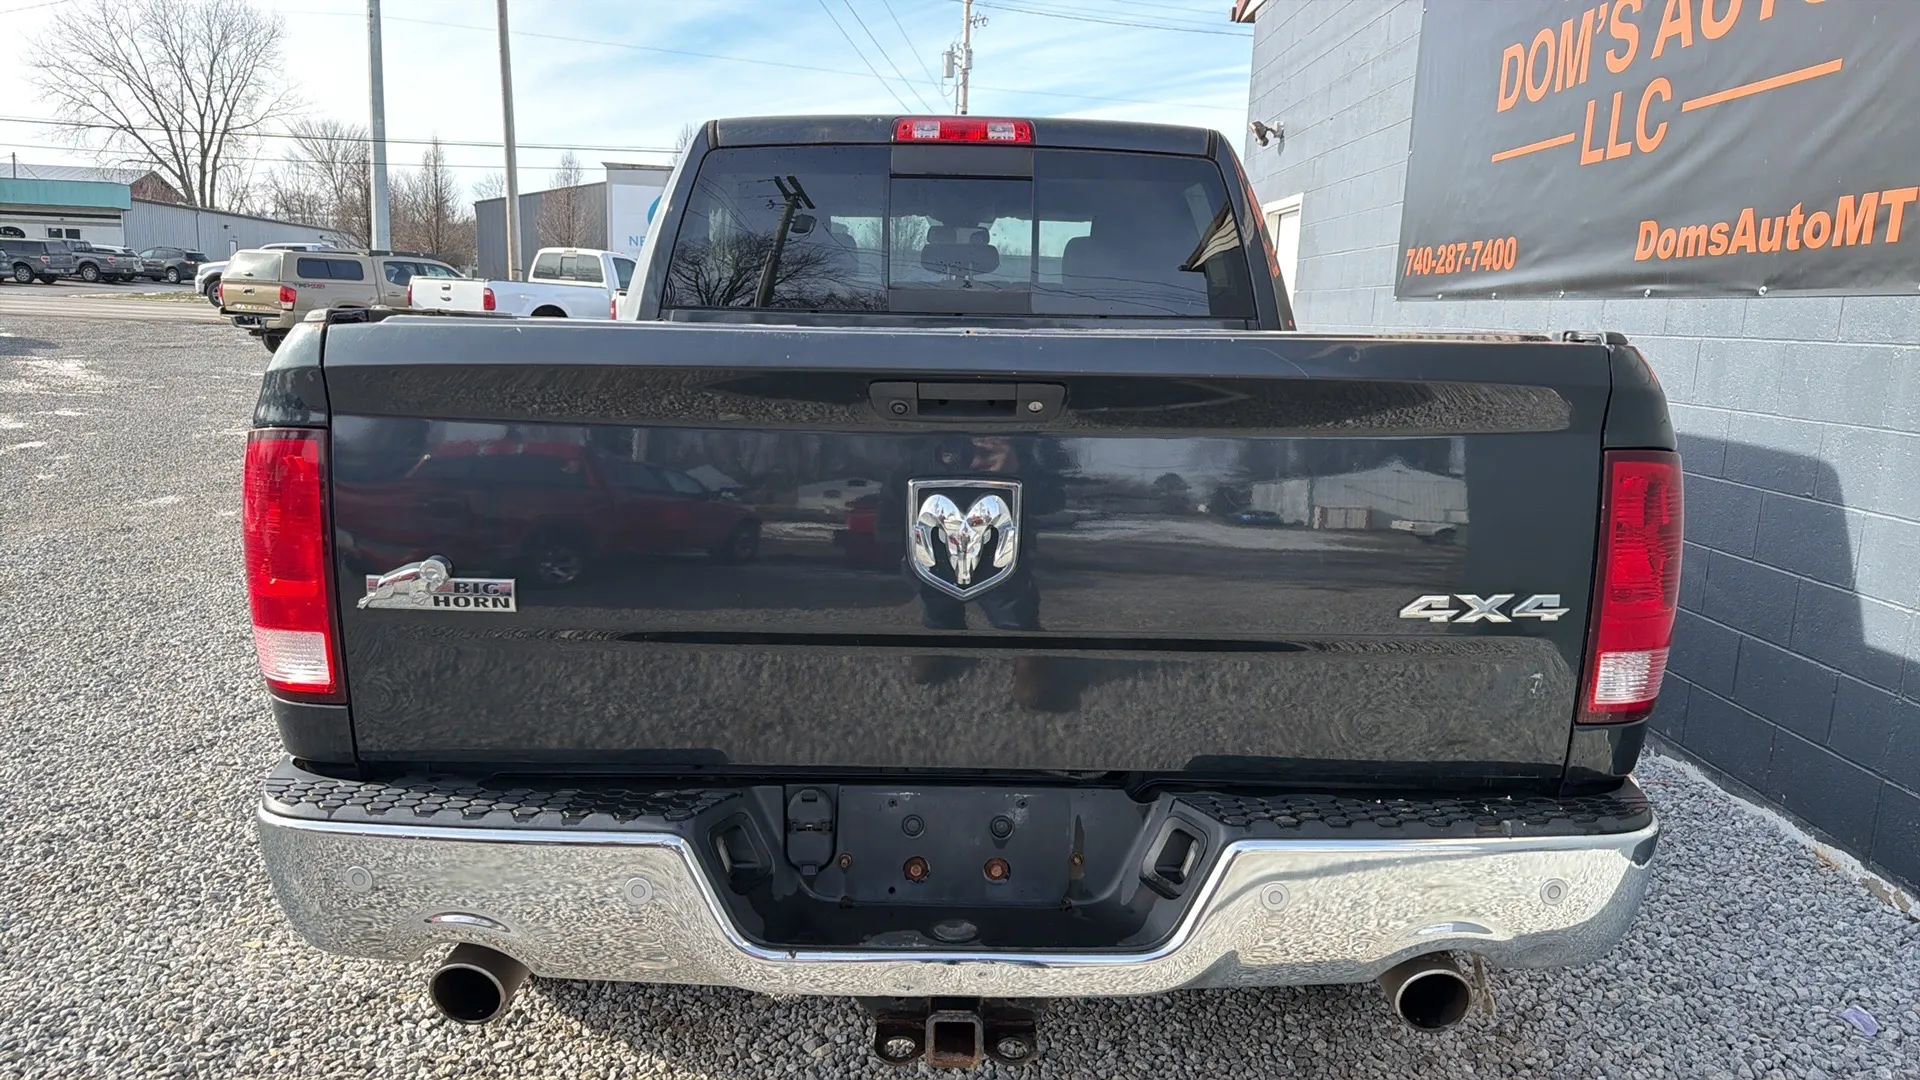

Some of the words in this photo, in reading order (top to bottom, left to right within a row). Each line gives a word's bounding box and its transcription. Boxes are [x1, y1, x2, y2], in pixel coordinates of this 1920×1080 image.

[1497, 0, 1644, 113] DOM'S
[1651, 0, 1825, 60] AU
[1579, 77, 1674, 166] LLC
[1634, 186, 1920, 262] DomsAutoMT
[1406, 236, 1519, 277] 740-287-7400
[433, 595, 511, 609] HORN
[454, 582, 500, 595] BIG
